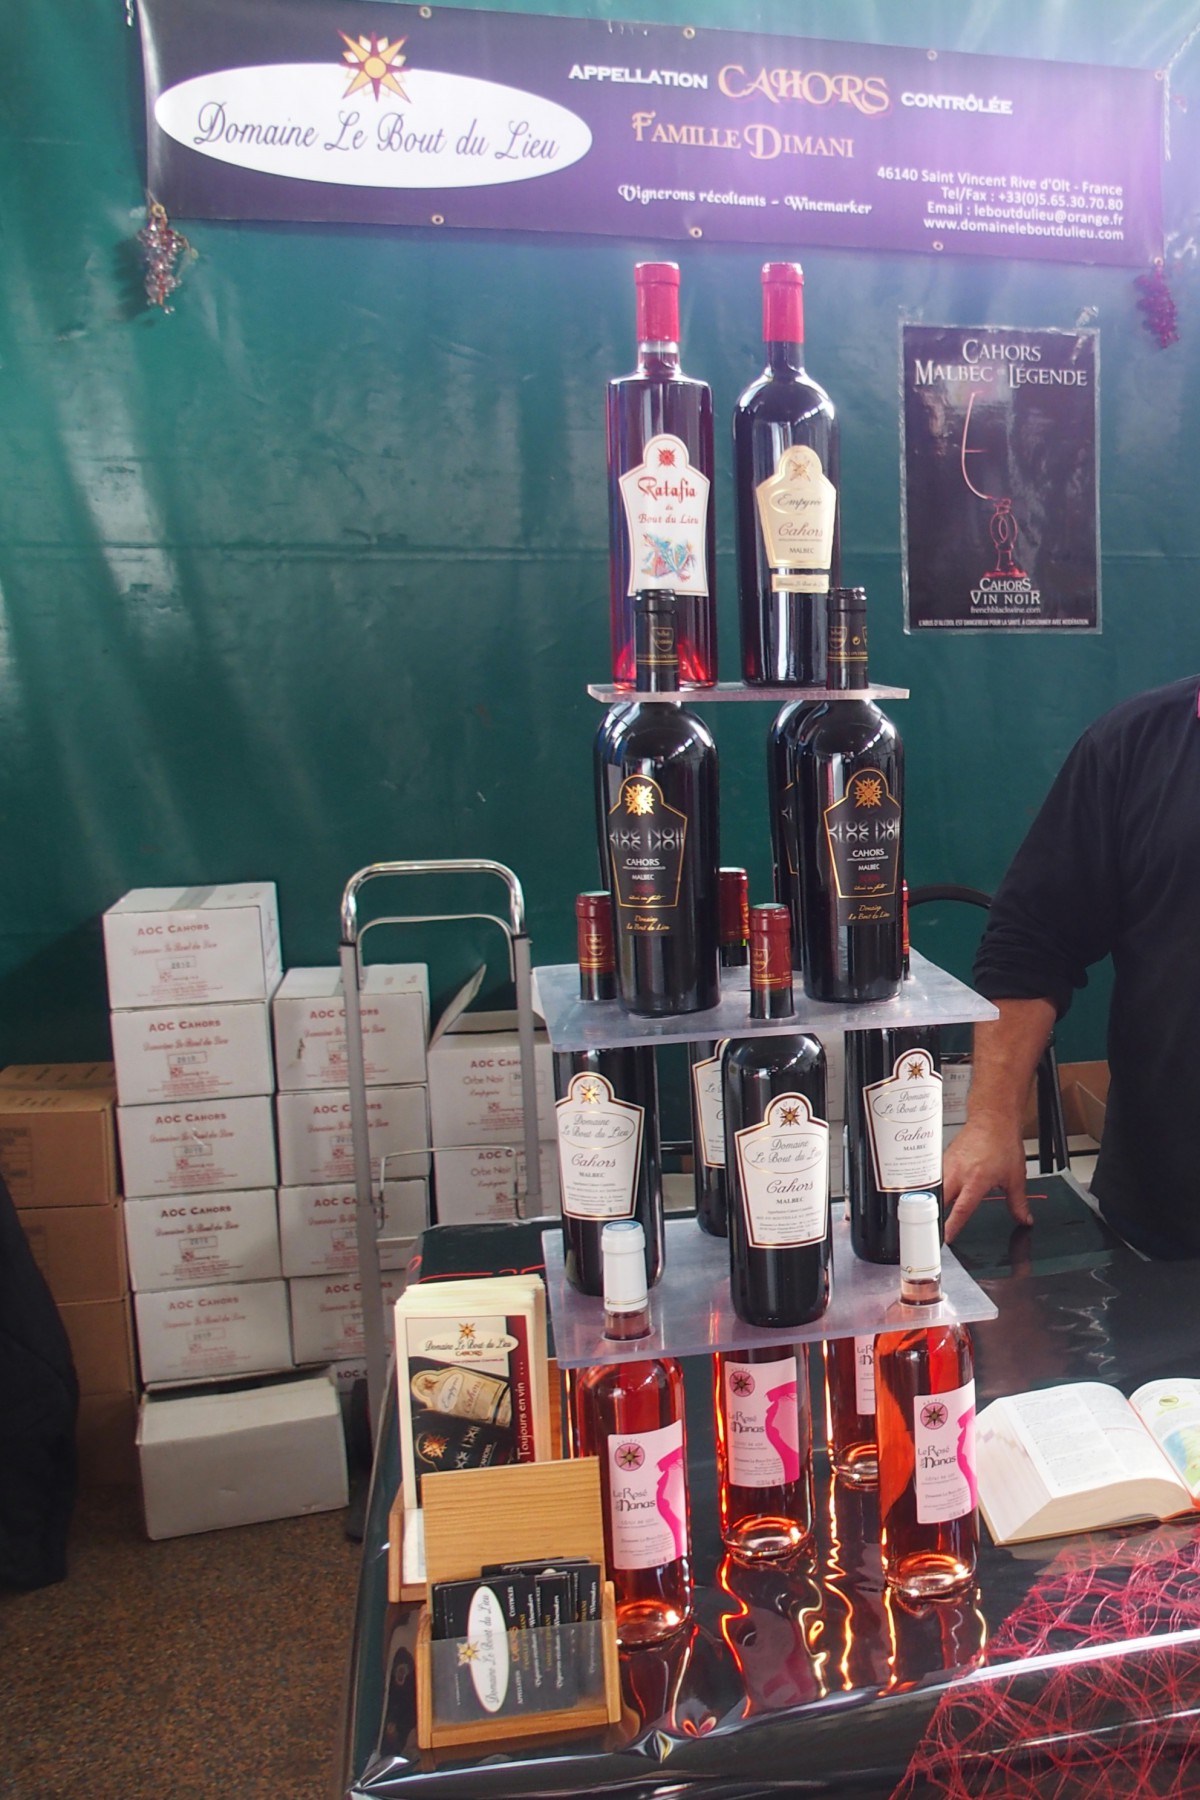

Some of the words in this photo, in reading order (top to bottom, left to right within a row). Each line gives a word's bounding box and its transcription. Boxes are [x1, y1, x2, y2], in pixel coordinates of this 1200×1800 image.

[569, 63, 708, 90] APPELLATION
[718, 65, 890, 116] CAHORS
[901, 91, 1014, 115] CONTRÔLÉE
[192, 100, 319, 149] Domaine
[324, 110, 367, 151] Le
[377, 112, 447, 154] Bout
[455, 118, 490, 156] du
[494, 119, 560, 160] Lieu
[632, 110, 742, 149] FAMILLE
[743, 124, 854, 160] DIMANI
[877, 166, 918, 181] 46140
[921, 169, 954, 185] Saint
[957, 172, 1007, 188] Vincent
[1010, 176, 1037, 190] Rive
[1040, 178, 1070, 193] d'Olt
[1081, 181, 1123, 197] France
[618, 184, 696, 205] Vignerons
[699, 188, 766, 208] récoltants
[784, 195, 873, 216] Winemarker
[941, 187, 987, 202] Tel/Fax
[998, 190, 1124, 211] +33(0)5.65.30.70.80
[927, 202, 963, 216] Email
[974, 204, 1124, 226] leboutdulieu@orange.fr
[923, 217, 1124, 241] www.domaineleboutdulieu.com
[962, 339, 1042, 364] CAHORS
[914, 359, 994, 386] MALBEC
[1008, 364, 1088, 389] LÉGENDE
[637, 476, 697, 504] Ratafia
[638, 513, 662, 524] Bout
[665, 514, 677, 524] du
[680, 514, 700, 524] Lieu
[778, 522, 824, 538] Cahors
[789, 547, 815, 555] MALBEC
[979, 577, 1032, 592] CAHORS
[970, 590, 998, 605] VIN
[1004, 590, 1041, 605] NOIR
[852, 848, 885, 857] CAHORS
[626, 858, 660, 866] CAHORS
[137, 926, 163, 936] AOC
[168, 924, 210, 933] CAHORS
[310, 1010, 335, 1019] AOC
[339, 1009, 379, 1017] CORS
[149, 1022, 175, 1032] AOC
[179, 1020, 221, 1029] CAHORS
[471, 1060, 494, 1068] AOC
[463, 1076, 485, 1085] Orbe
[898, 1091, 930, 1102] Domaine
[313, 1105, 338, 1114] AOC
[342, 1104, 382, 1112] CORS
[881, 1103, 893, 1114] Le
[896, 1102, 918, 1114] Bout
[919, 1100, 929, 1111] du
[155, 1115, 181, 1124] AOC
[185, 1113, 227, 1122] CAHORS
[573, 1114, 609, 1125] Domaine
[572, 1126, 591, 1138] Bout
[894, 1128, 934, 1142] Cahors
[771, 1139, 809, 1151] Domaine
[479, 1152, 502, 1160] AOC
[571, 1153, 616, 1168] Cahors
[752, 1152, 765, 1163] Le
[768, 1152, 791, 1163] Bout
[795, 1150, 805, 1161] du
[471, 1168, 492, 1176] Orbe
[766, 1178, 814, 1194] Cahors
[314, 1198, 338, 1207] AOC
[161, 1208, 187, 1217] AOC
[191, 1205, 232, 1215] CAHORS
[325, 1284, 349, 1294] AOC
[169, 1301, 193, 1310] AOC
[198, 1297, 239, 1307] CAHORS
[425, 1340, 453, 1351] Domaine
[455, 1339, 466, 1350] Le
[468, 1339, 484, 1349] Bout
[486, 1340, 494, 1348] du
[496, 1338, 512, 1349] Lieu
[337, 1369, 360, 1379] AOC
[517, 1382, 526, 1396] vin
[519, 1399, 526, 1411] en
[734, 1422, 764, 1433] Nanas
[517, 1413, 532, 1460] Toujours
[918, 1447, 927, 1456] Le
[928, 1445, 950, 1457] Rosé
[925, 1456, 956, 1468] Nanas
[613, 1489, 623, 1498] Le
[623, 1487, 647, 1500] Rosé
[620, 1500, 656, 1512] Nanas
[478, 1594, 492, 1613] Lieu
[480, 1630, 492, 1651] Bout
[482, 1653, 497, 1666] Le
[485, 1666, 499, 1703] Domaine
